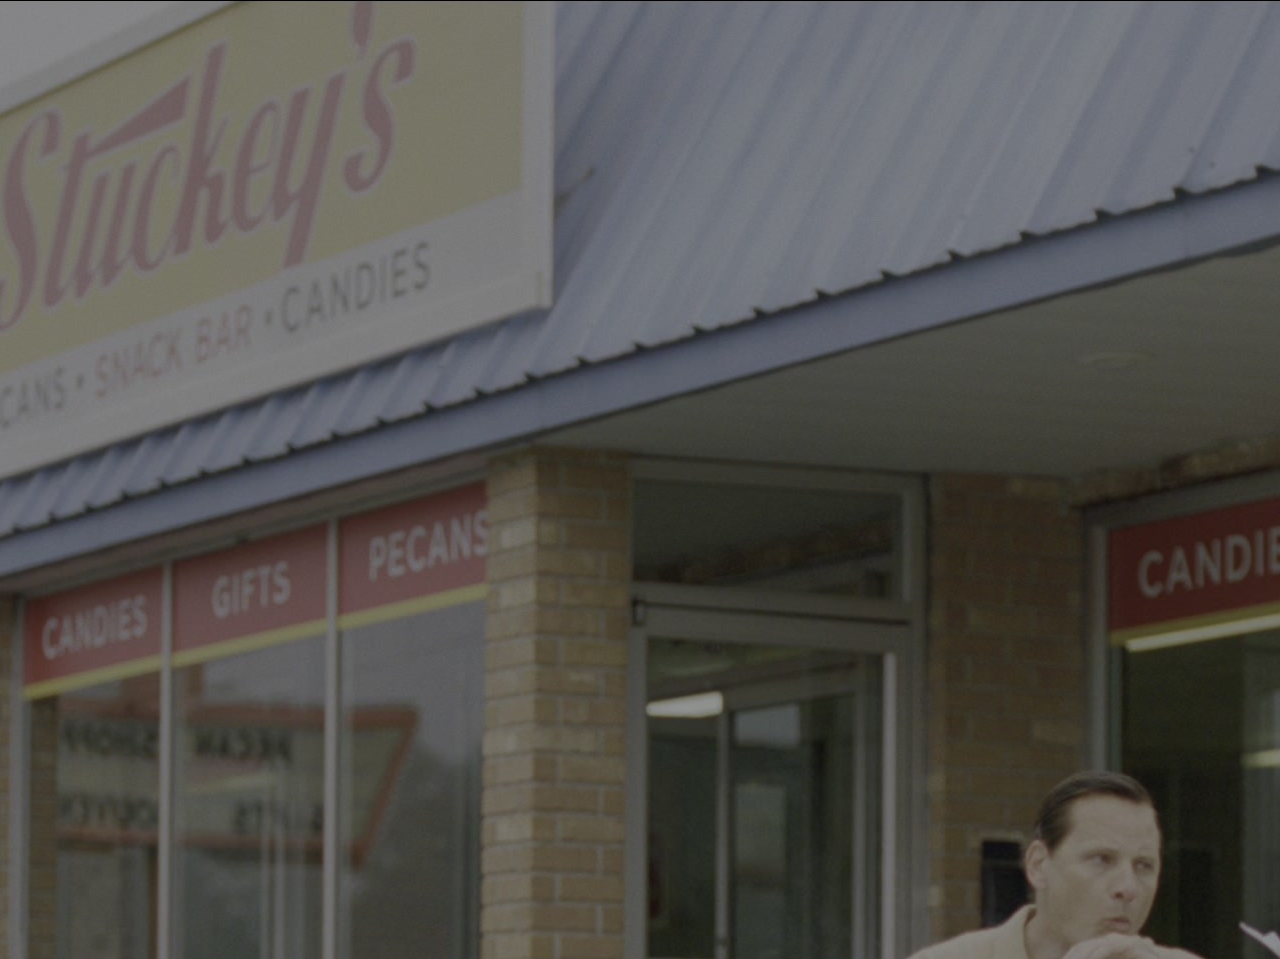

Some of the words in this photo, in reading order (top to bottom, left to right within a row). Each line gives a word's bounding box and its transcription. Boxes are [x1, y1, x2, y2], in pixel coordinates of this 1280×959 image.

[94, 325, 184, 398] SNACK
[195, 304, 252, 365] BAR
[280, 241, 432, 334] CANDIES
[368, 509, 488, 583] PECANS
[211, 560, 291, 619] GIFTS
[41, 594, 149, 660] CANDIES
